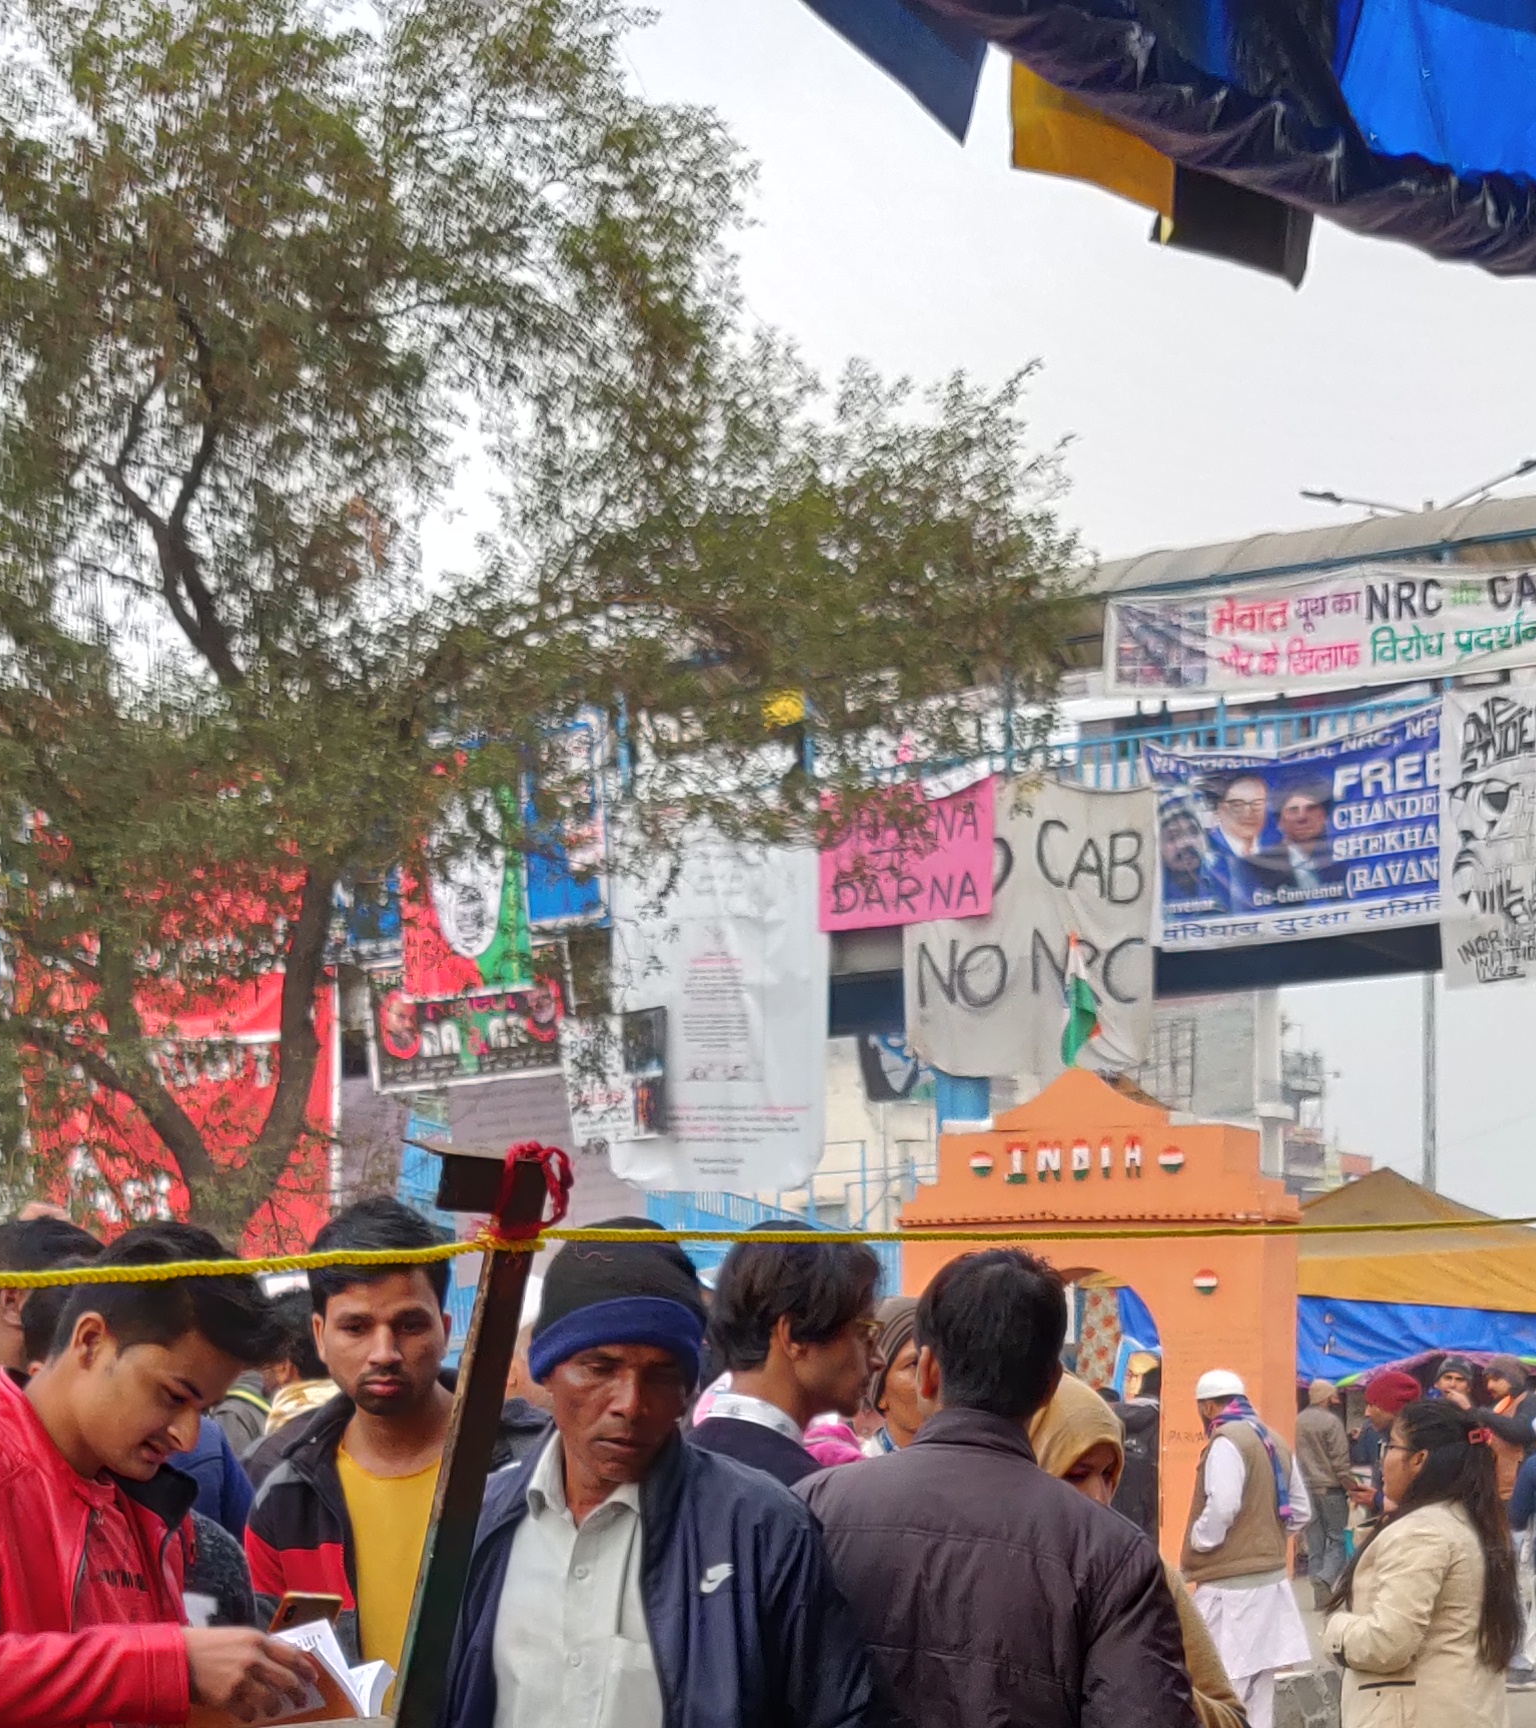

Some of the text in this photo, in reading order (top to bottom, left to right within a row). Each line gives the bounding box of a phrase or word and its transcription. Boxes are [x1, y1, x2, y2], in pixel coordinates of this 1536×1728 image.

[1210, 595, 1290, 635] मेवात
[1364, 578, 1443, 625] NRC
[1370, 624, 1444, 667] विरोध
[1035, 819, 1144, 905] CAB
[830, 870, 980, 916] DARNA
[917, 939, 1009, 1008] NO
[1004, 1134, 1143, 1184] INDIA
